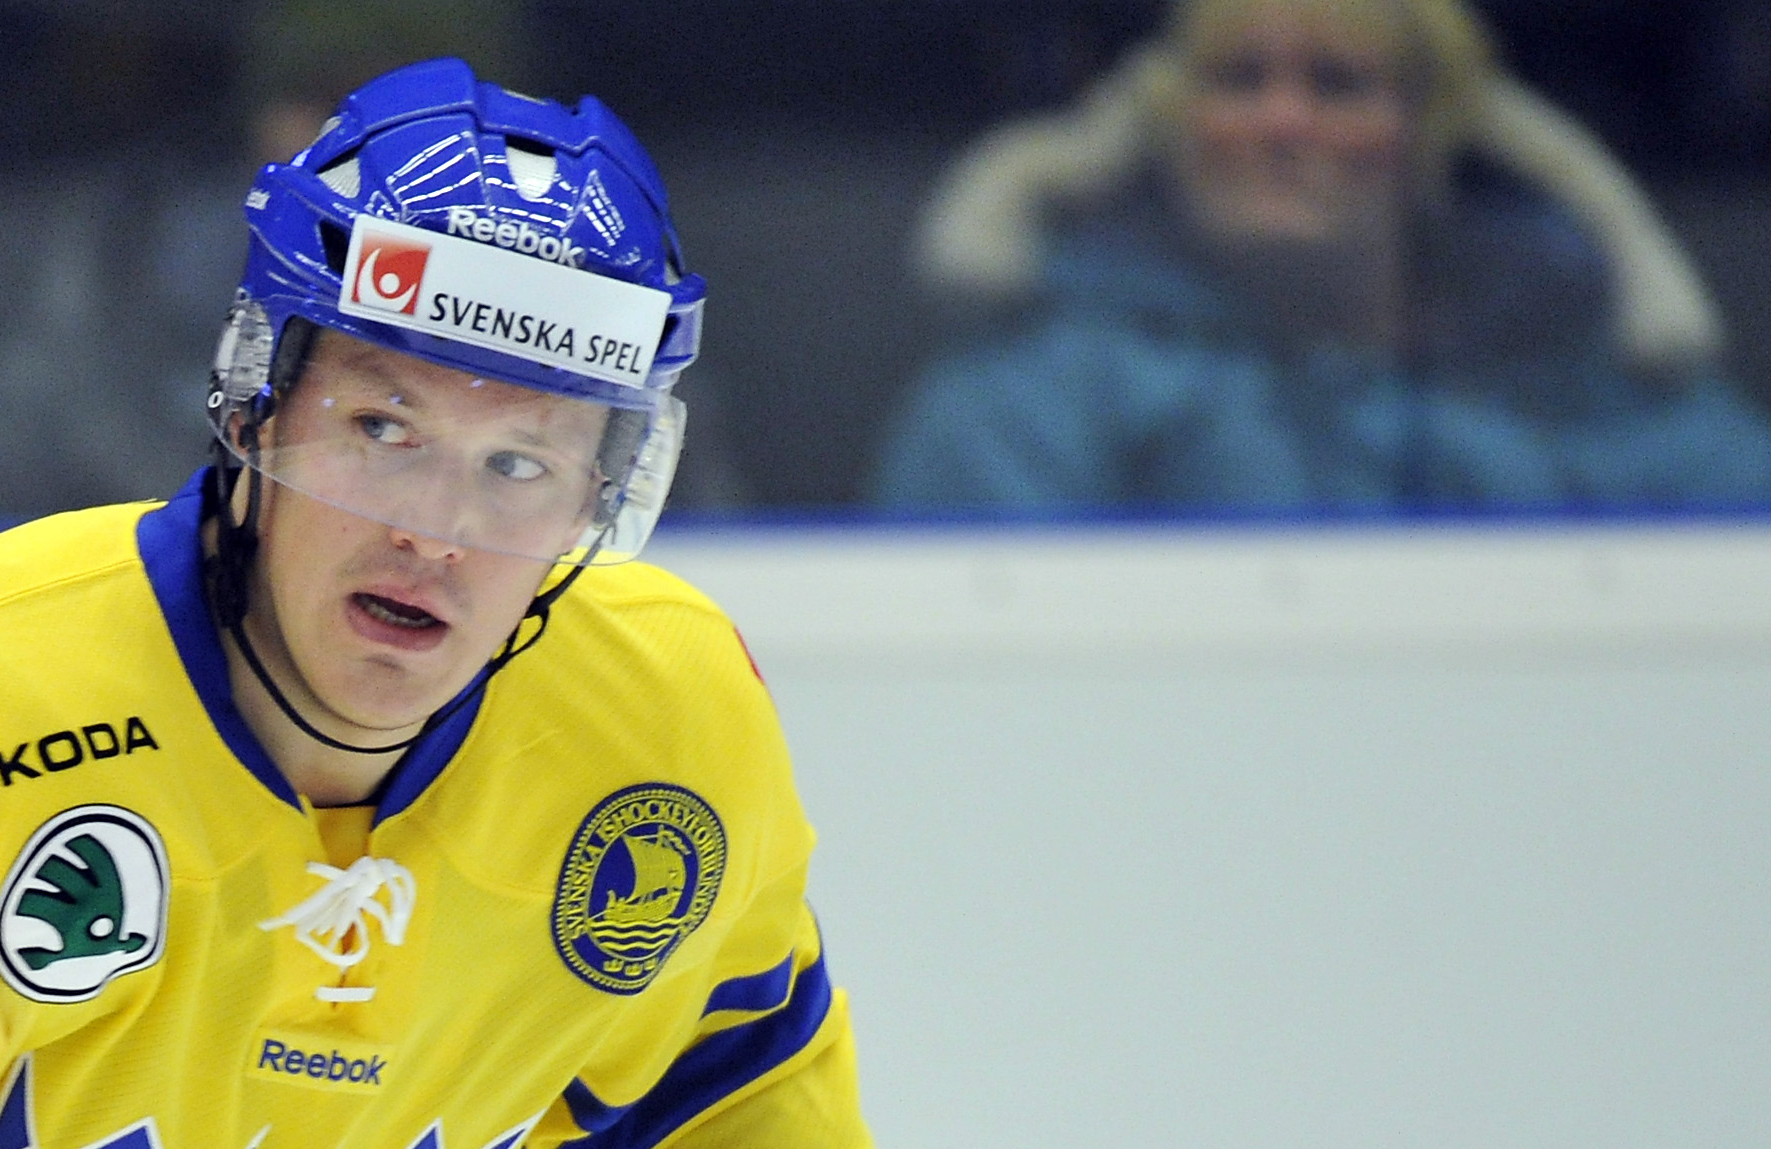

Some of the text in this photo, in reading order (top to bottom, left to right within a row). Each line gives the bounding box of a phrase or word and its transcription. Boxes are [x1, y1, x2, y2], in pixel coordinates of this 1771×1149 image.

[447, 208, 585, 268] Reebok
[429, 293, 642, 374] SVENSKA SPEL
[258, 1038, 388, 1085] Reebok
